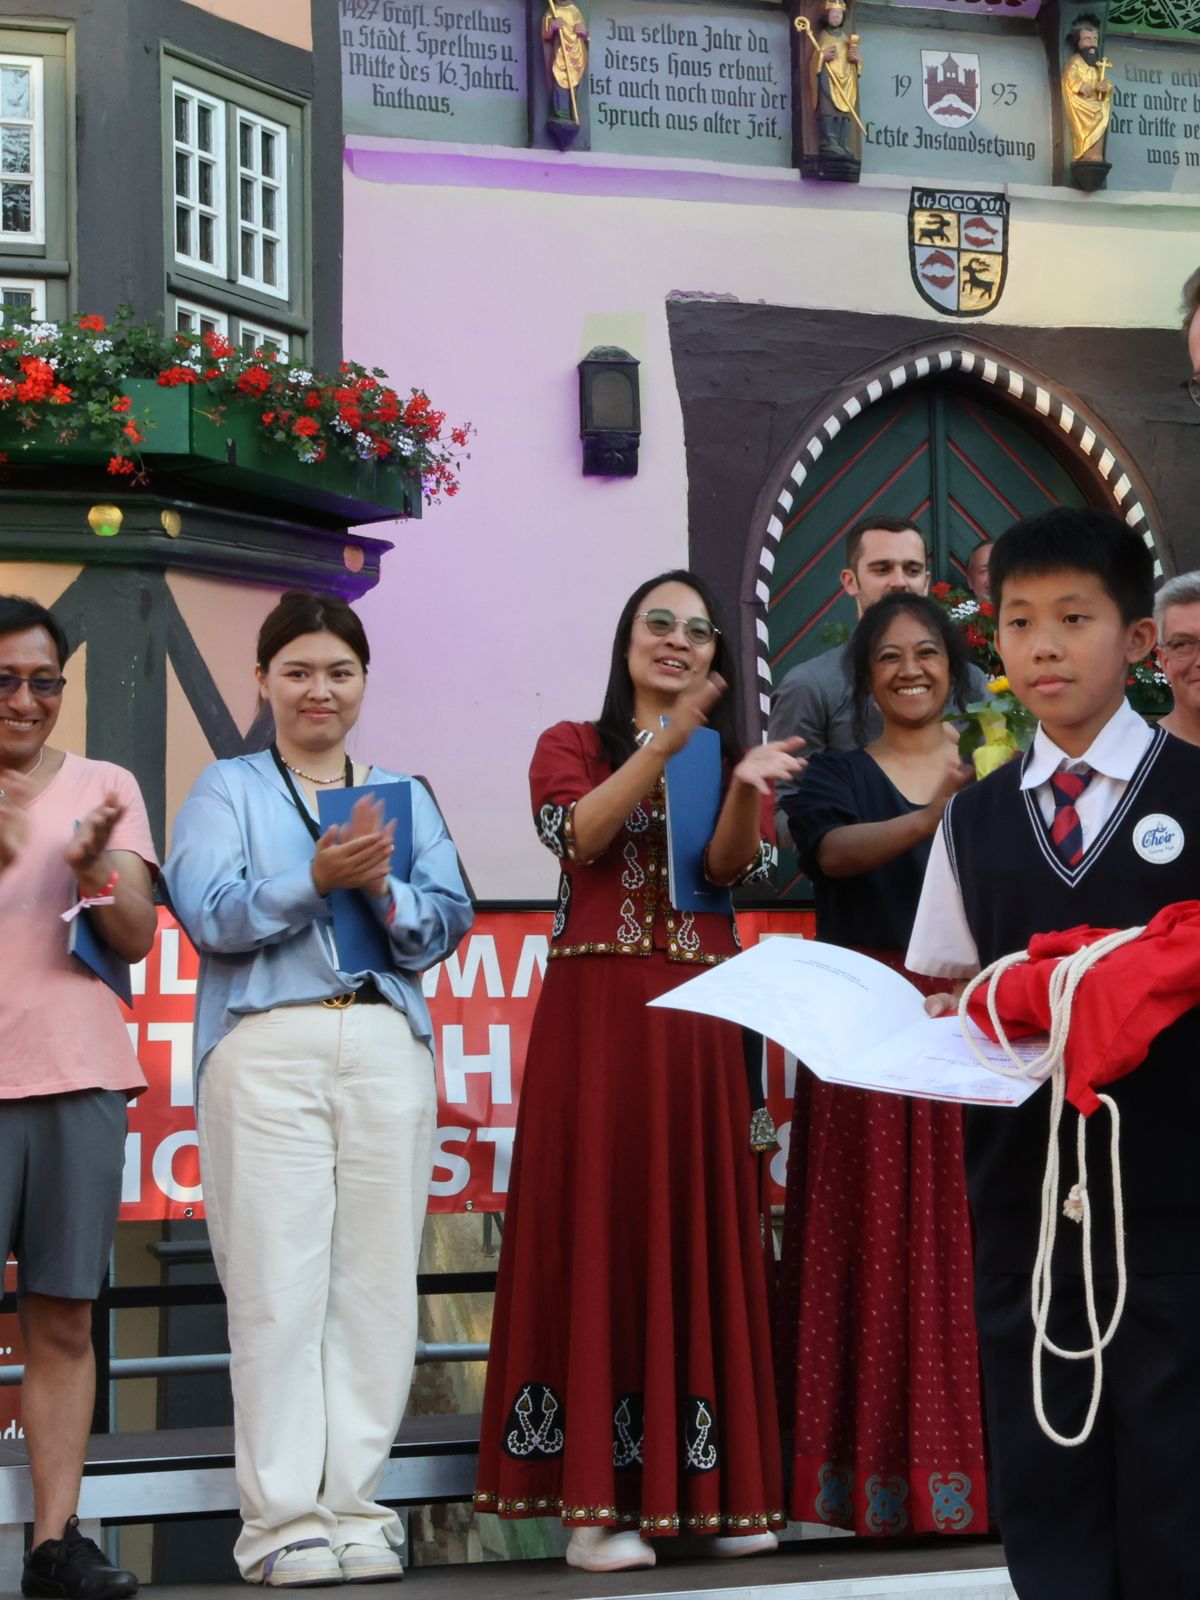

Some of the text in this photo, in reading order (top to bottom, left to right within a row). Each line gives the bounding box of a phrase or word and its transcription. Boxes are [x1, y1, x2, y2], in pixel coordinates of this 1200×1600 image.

[434, 6, 512, 34] Speelhus
[416, 31, 497, 61] Speelhus
[501, 45, 518, 63] u.
[604, 18, 770, 54] Im selben Jahr da
[350, 52, 395, 79] Mitte
[400, 57, 430, 83] des
[435, 60, 458, 86] 16.
[605, 47, 660, 73] dieses
[1124, 63, 1163, 85] Einer
[590, 74, 788, 110] ist auch noch wahr der
[891, 74, 1019, 106] 19 93
[1113, 86, 1137, 108] der
[1144, 90, 1187, 113] andre
[598, 102, 660, 130] Spruch
[666, 112, 698, 132] aus
[703, 110, 742, 135] alter
[1110, 112, 1133, 134] der
[1139, 114, 1176, 138] dritte
[865, 122, 1036, 161] Letzte Instandsetzung
[1147, 148, 1180, 166] was
[1141, 828, 1176, 849] Choir
